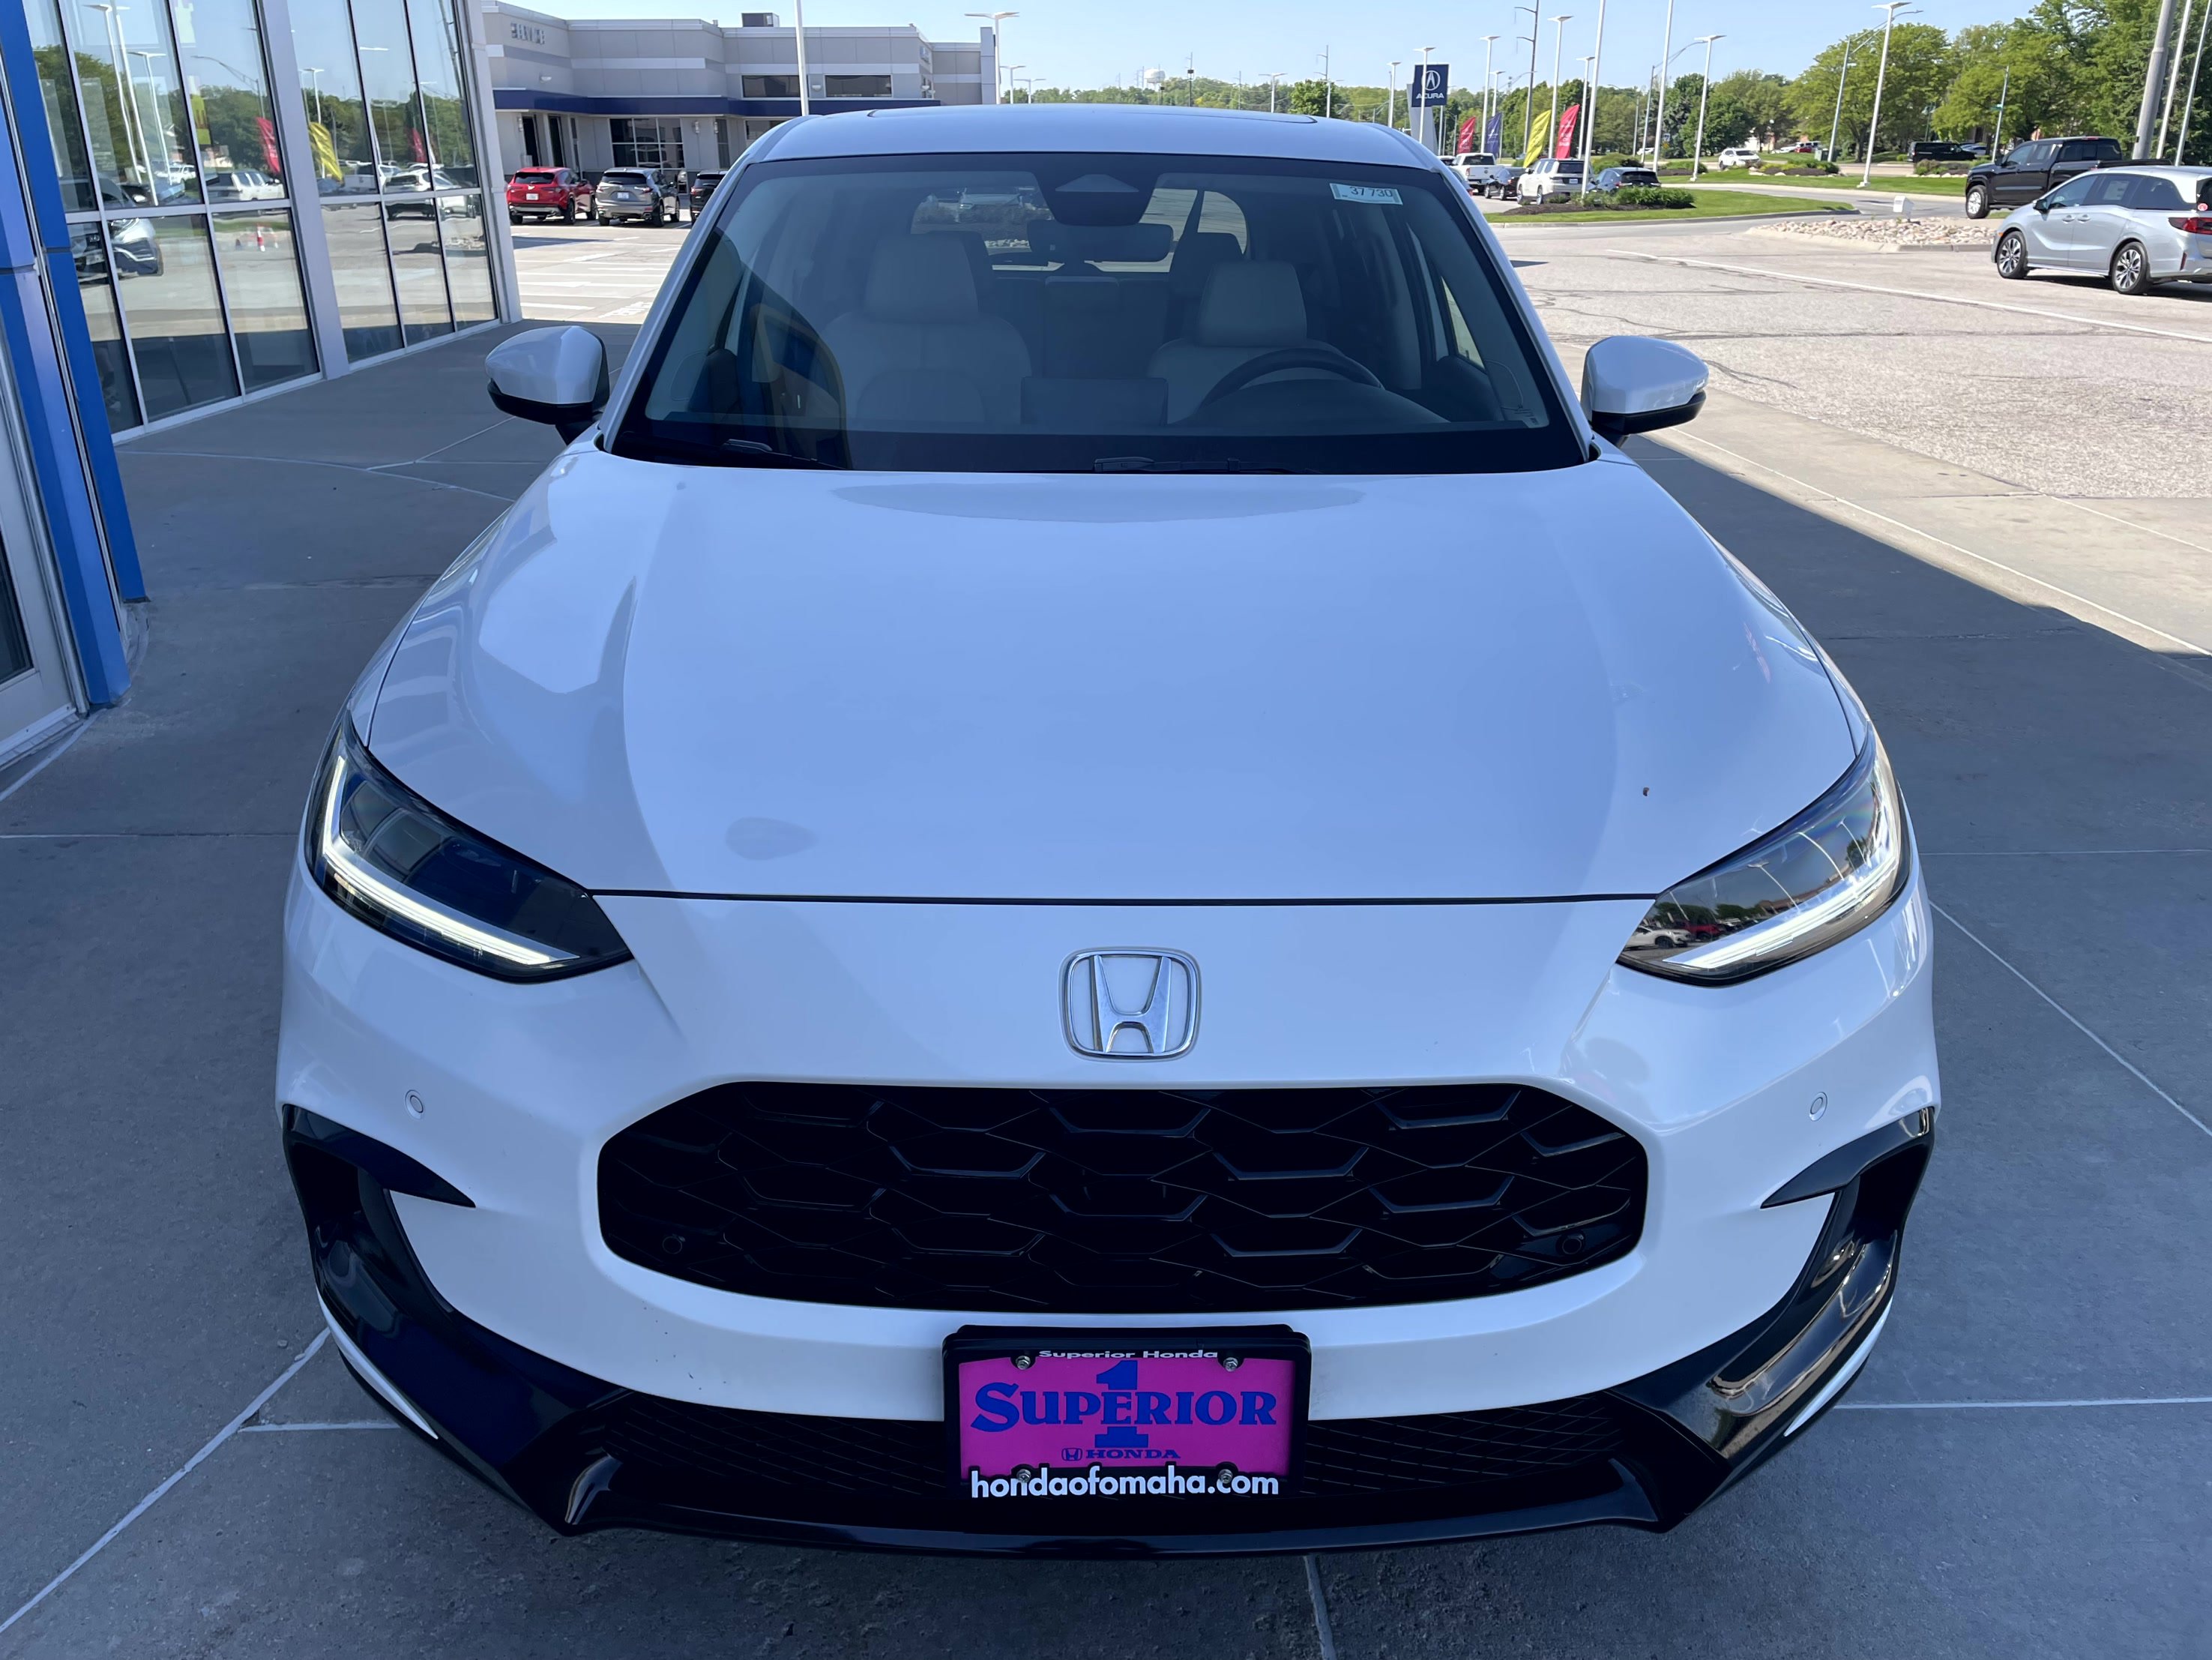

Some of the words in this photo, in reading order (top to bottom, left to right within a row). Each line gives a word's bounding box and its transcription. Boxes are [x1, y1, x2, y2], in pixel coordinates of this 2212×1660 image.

[1039, 1350, 1136, 1359] Superior
[1143, 1350, 1218, 1359] Honda
[971, 1382, 1277, 1433] SUPERIOR
[1086, 1449, 1181, 1459] HONDA
[971, 1465, 1279, 1498] hondaofomaha.com
